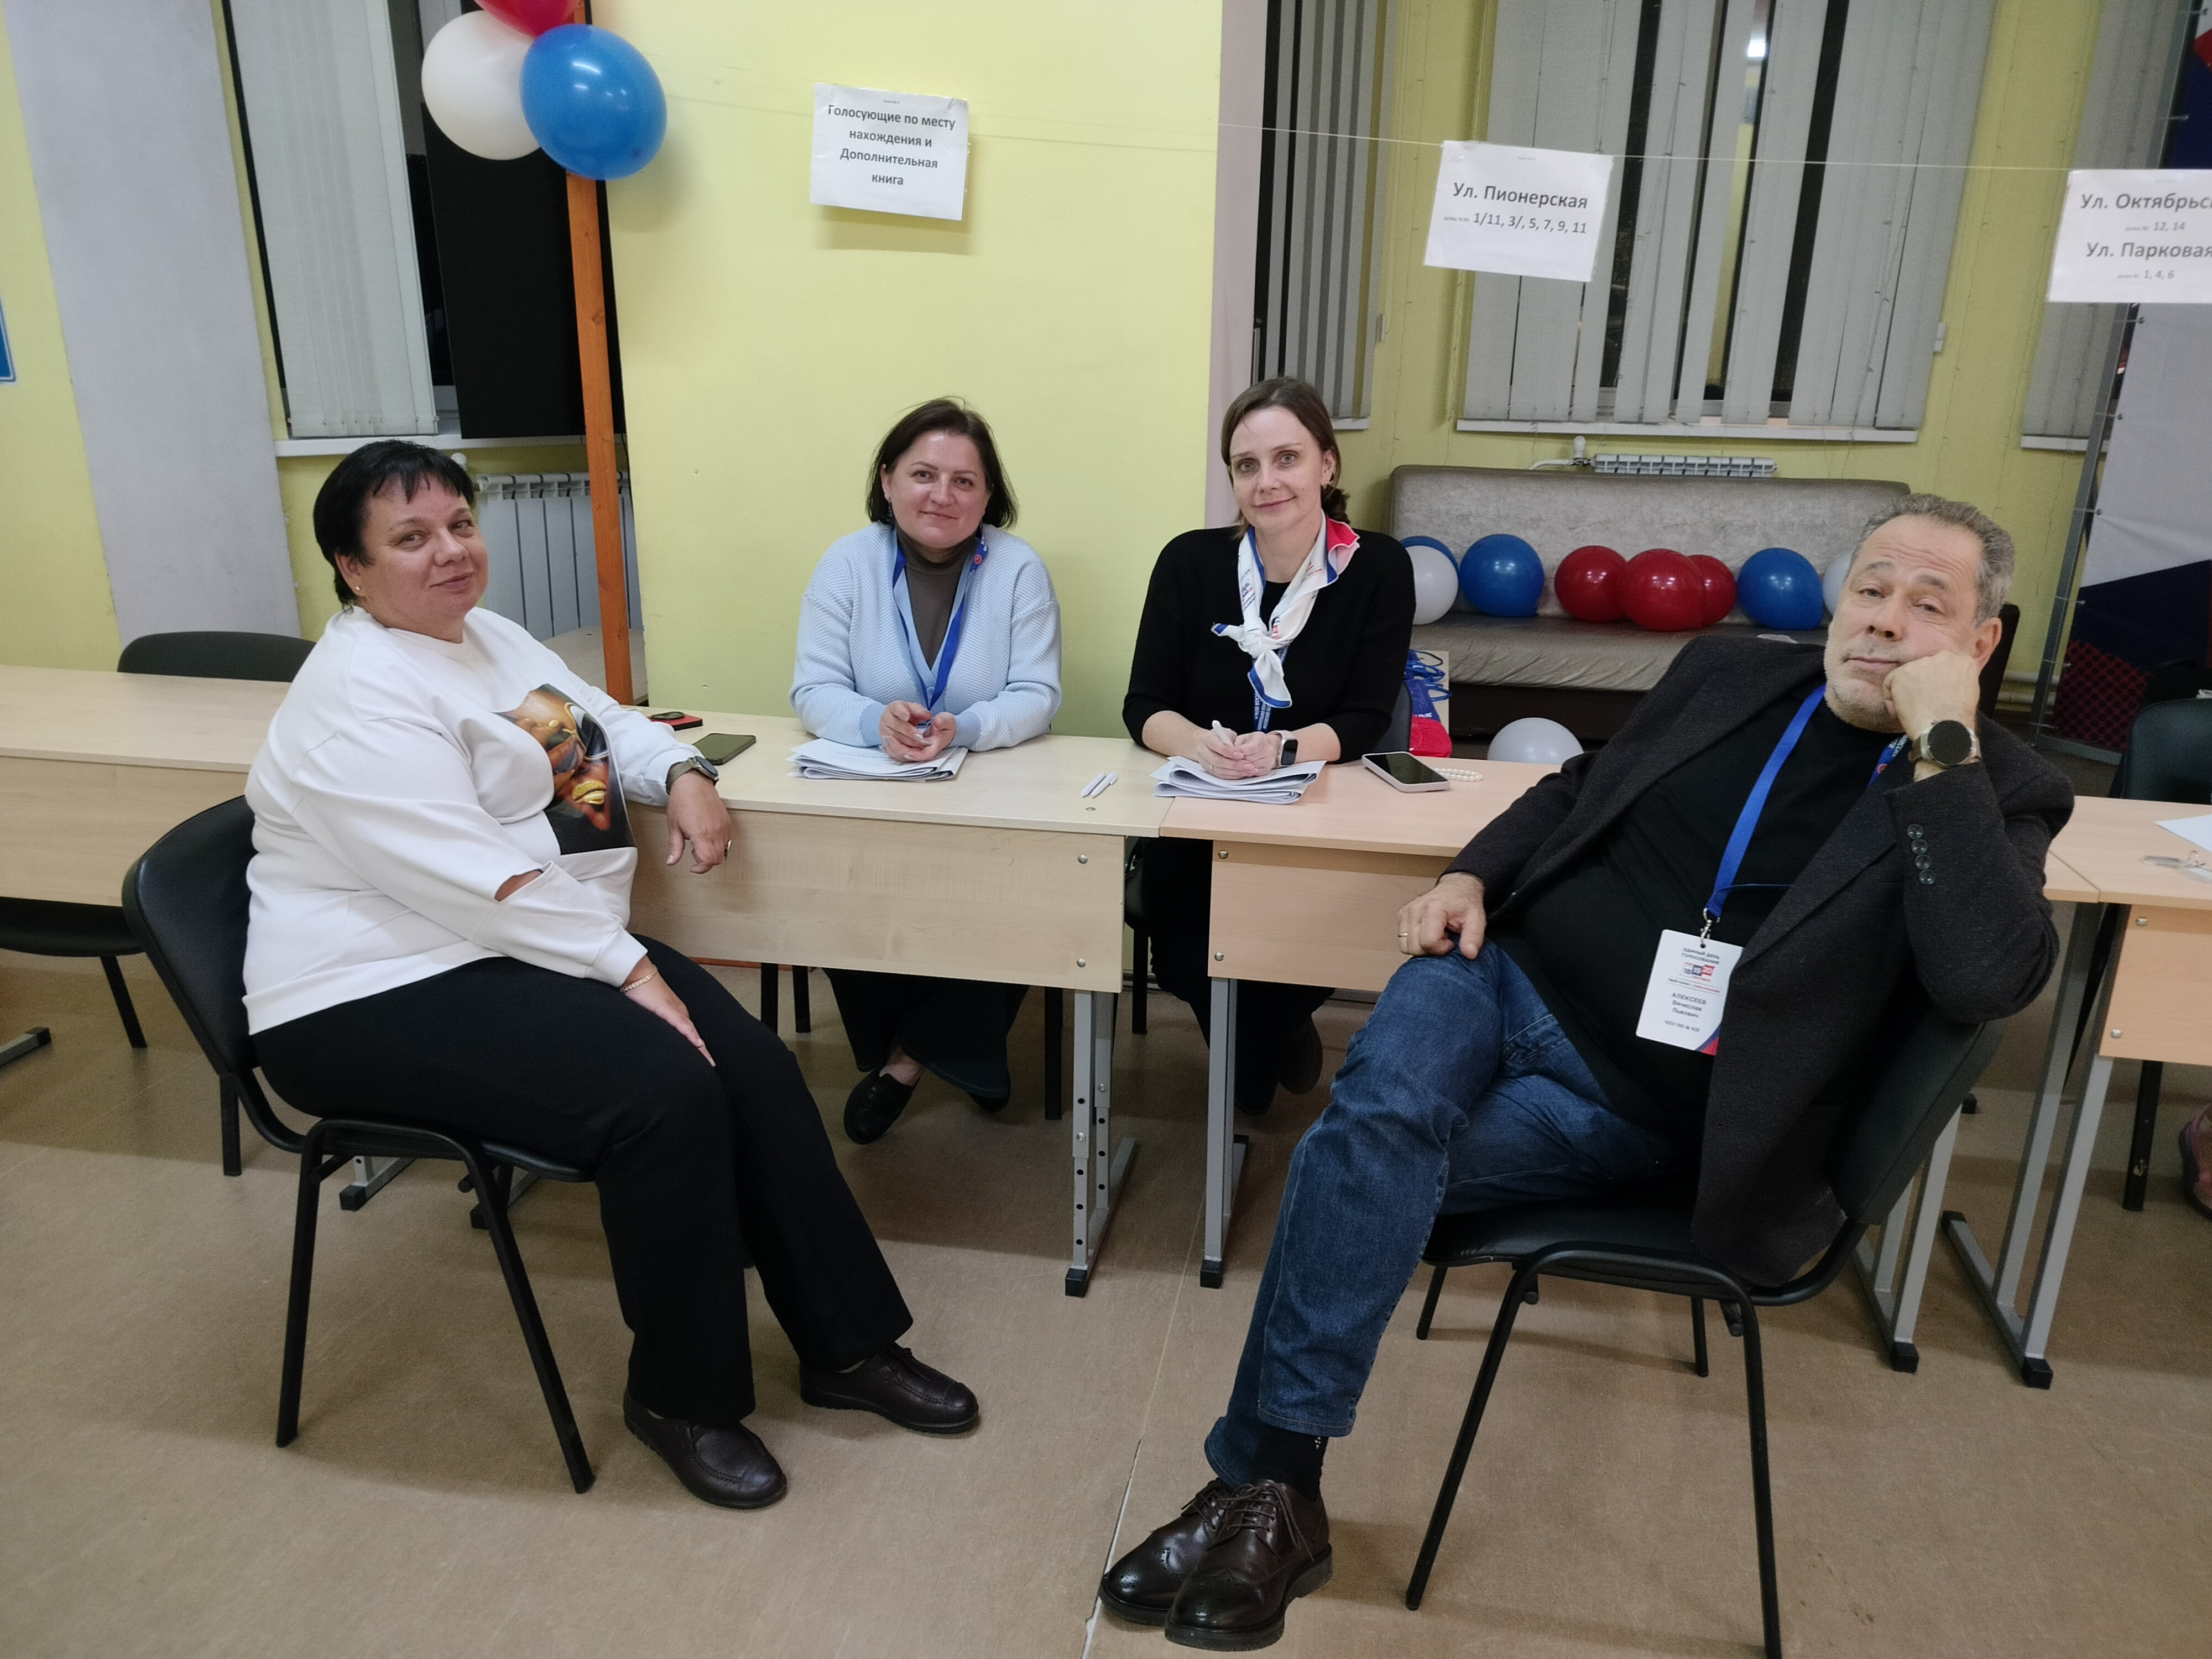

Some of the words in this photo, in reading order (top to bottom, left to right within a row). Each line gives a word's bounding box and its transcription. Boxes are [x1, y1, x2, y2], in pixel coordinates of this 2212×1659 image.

[828, 105, 901, 123] Голосующие
[905, 115, 918, 124] по
[921, 117, 956, 131] месту
[849, 130, 922, 146] нахождения
[925, 138, 932, 147] и
[840, 148, 938, 168] Дополнительная
[872, 174, 904, 185] книга
[1453, 182, 1478, 199] Ул.
[1484, 185, 1588, 209] Пионерская
[2080, 194, 2108, 209] Ул.
[2116, 192, 2212, 212] Октябрьс
[1473, 212, 1504, 227] 1/11,
[1508, 215, 1525, 230] 3/,
[1528, 218, 1539, 231] 5,
[1543, 219, 1554, 232] 7,
[1557, 221, 1568, 233] 9,
[1572, 222, 1587, 233] 11
[2153, 222, 2169, 232] 12,
[2172, 222, 2185, 231] 14
[2086, 242, 2114, 257] Ул.
[2121, 242, 2212, 261] Парковая
[2143, 270, 2152, 280] 1,
[2155, 270, 2164, 280] 4,
[2168, 270, 2174, 279] 6
[1671, 993, 1707, 1005] АЛЕКСЕЕВ
[1672, 1000, 1702, 1011] Вячеслав
[1671, 1008, 1699, 1018] Львович
